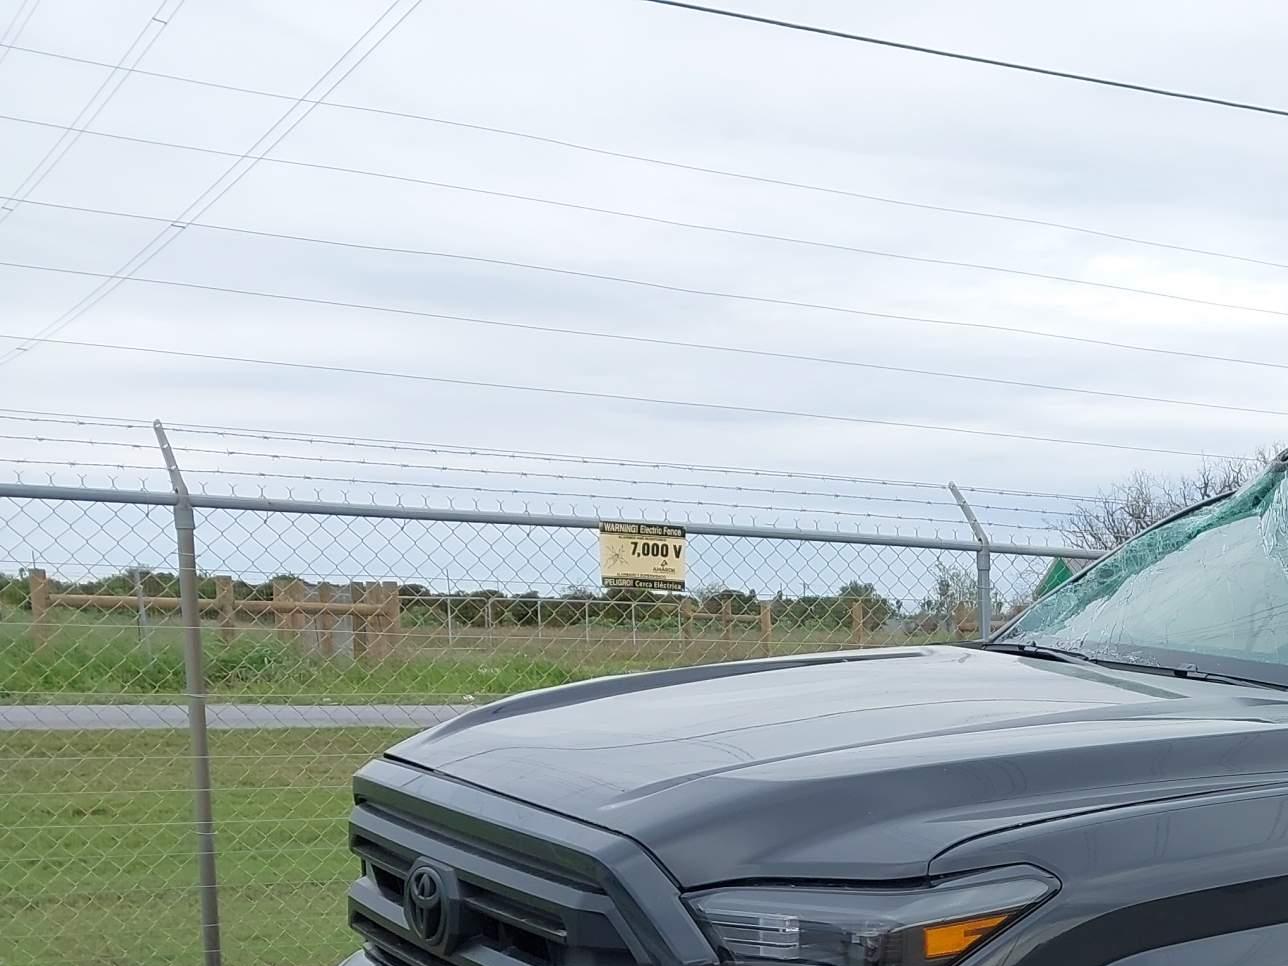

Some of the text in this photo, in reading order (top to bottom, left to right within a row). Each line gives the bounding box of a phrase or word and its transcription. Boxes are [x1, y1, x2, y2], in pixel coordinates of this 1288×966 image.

[640, 525, 662, 535] Electric
[663, 526, 682, 536] Fence
[630, 541, 682, 559] 7,000 V
